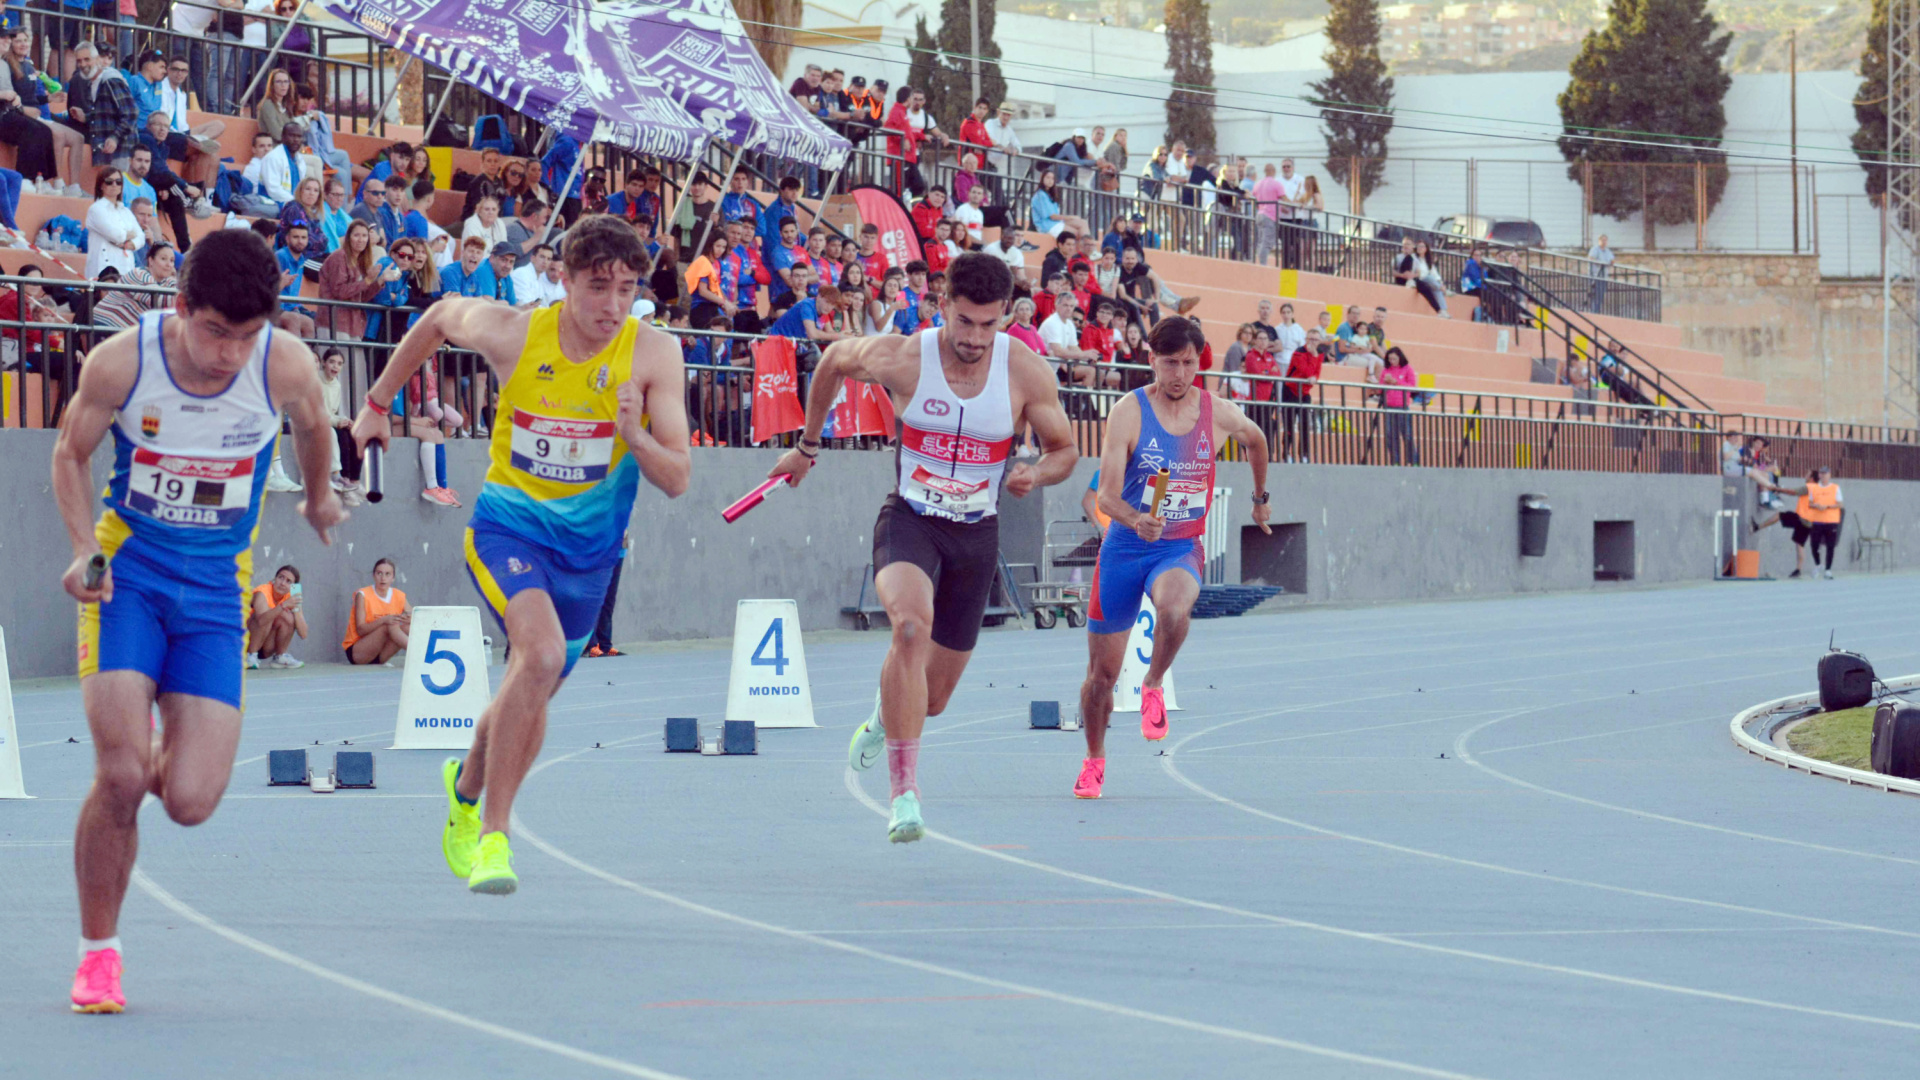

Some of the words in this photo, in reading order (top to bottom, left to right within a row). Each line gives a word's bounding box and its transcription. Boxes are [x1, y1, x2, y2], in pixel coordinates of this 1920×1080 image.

[535, 438, 550, 458] 9
[922, 436, 991, 456] ELCHE
[529, 461, 586, 480] Joma
[1169, 459, 1211, 474] lapalma
[150, 472, 184, 502] 19
[152, 501, 220, 525] Joma
[1164, 510, 1190, 519] oma
[750, 617, 790, 676] 4
[1136, 609, 1155, 665] 3
[420, 629, 466, 696] 5
[748, 686, 801, 696] MONDO
[414, 717, 474, 728] MONDO
